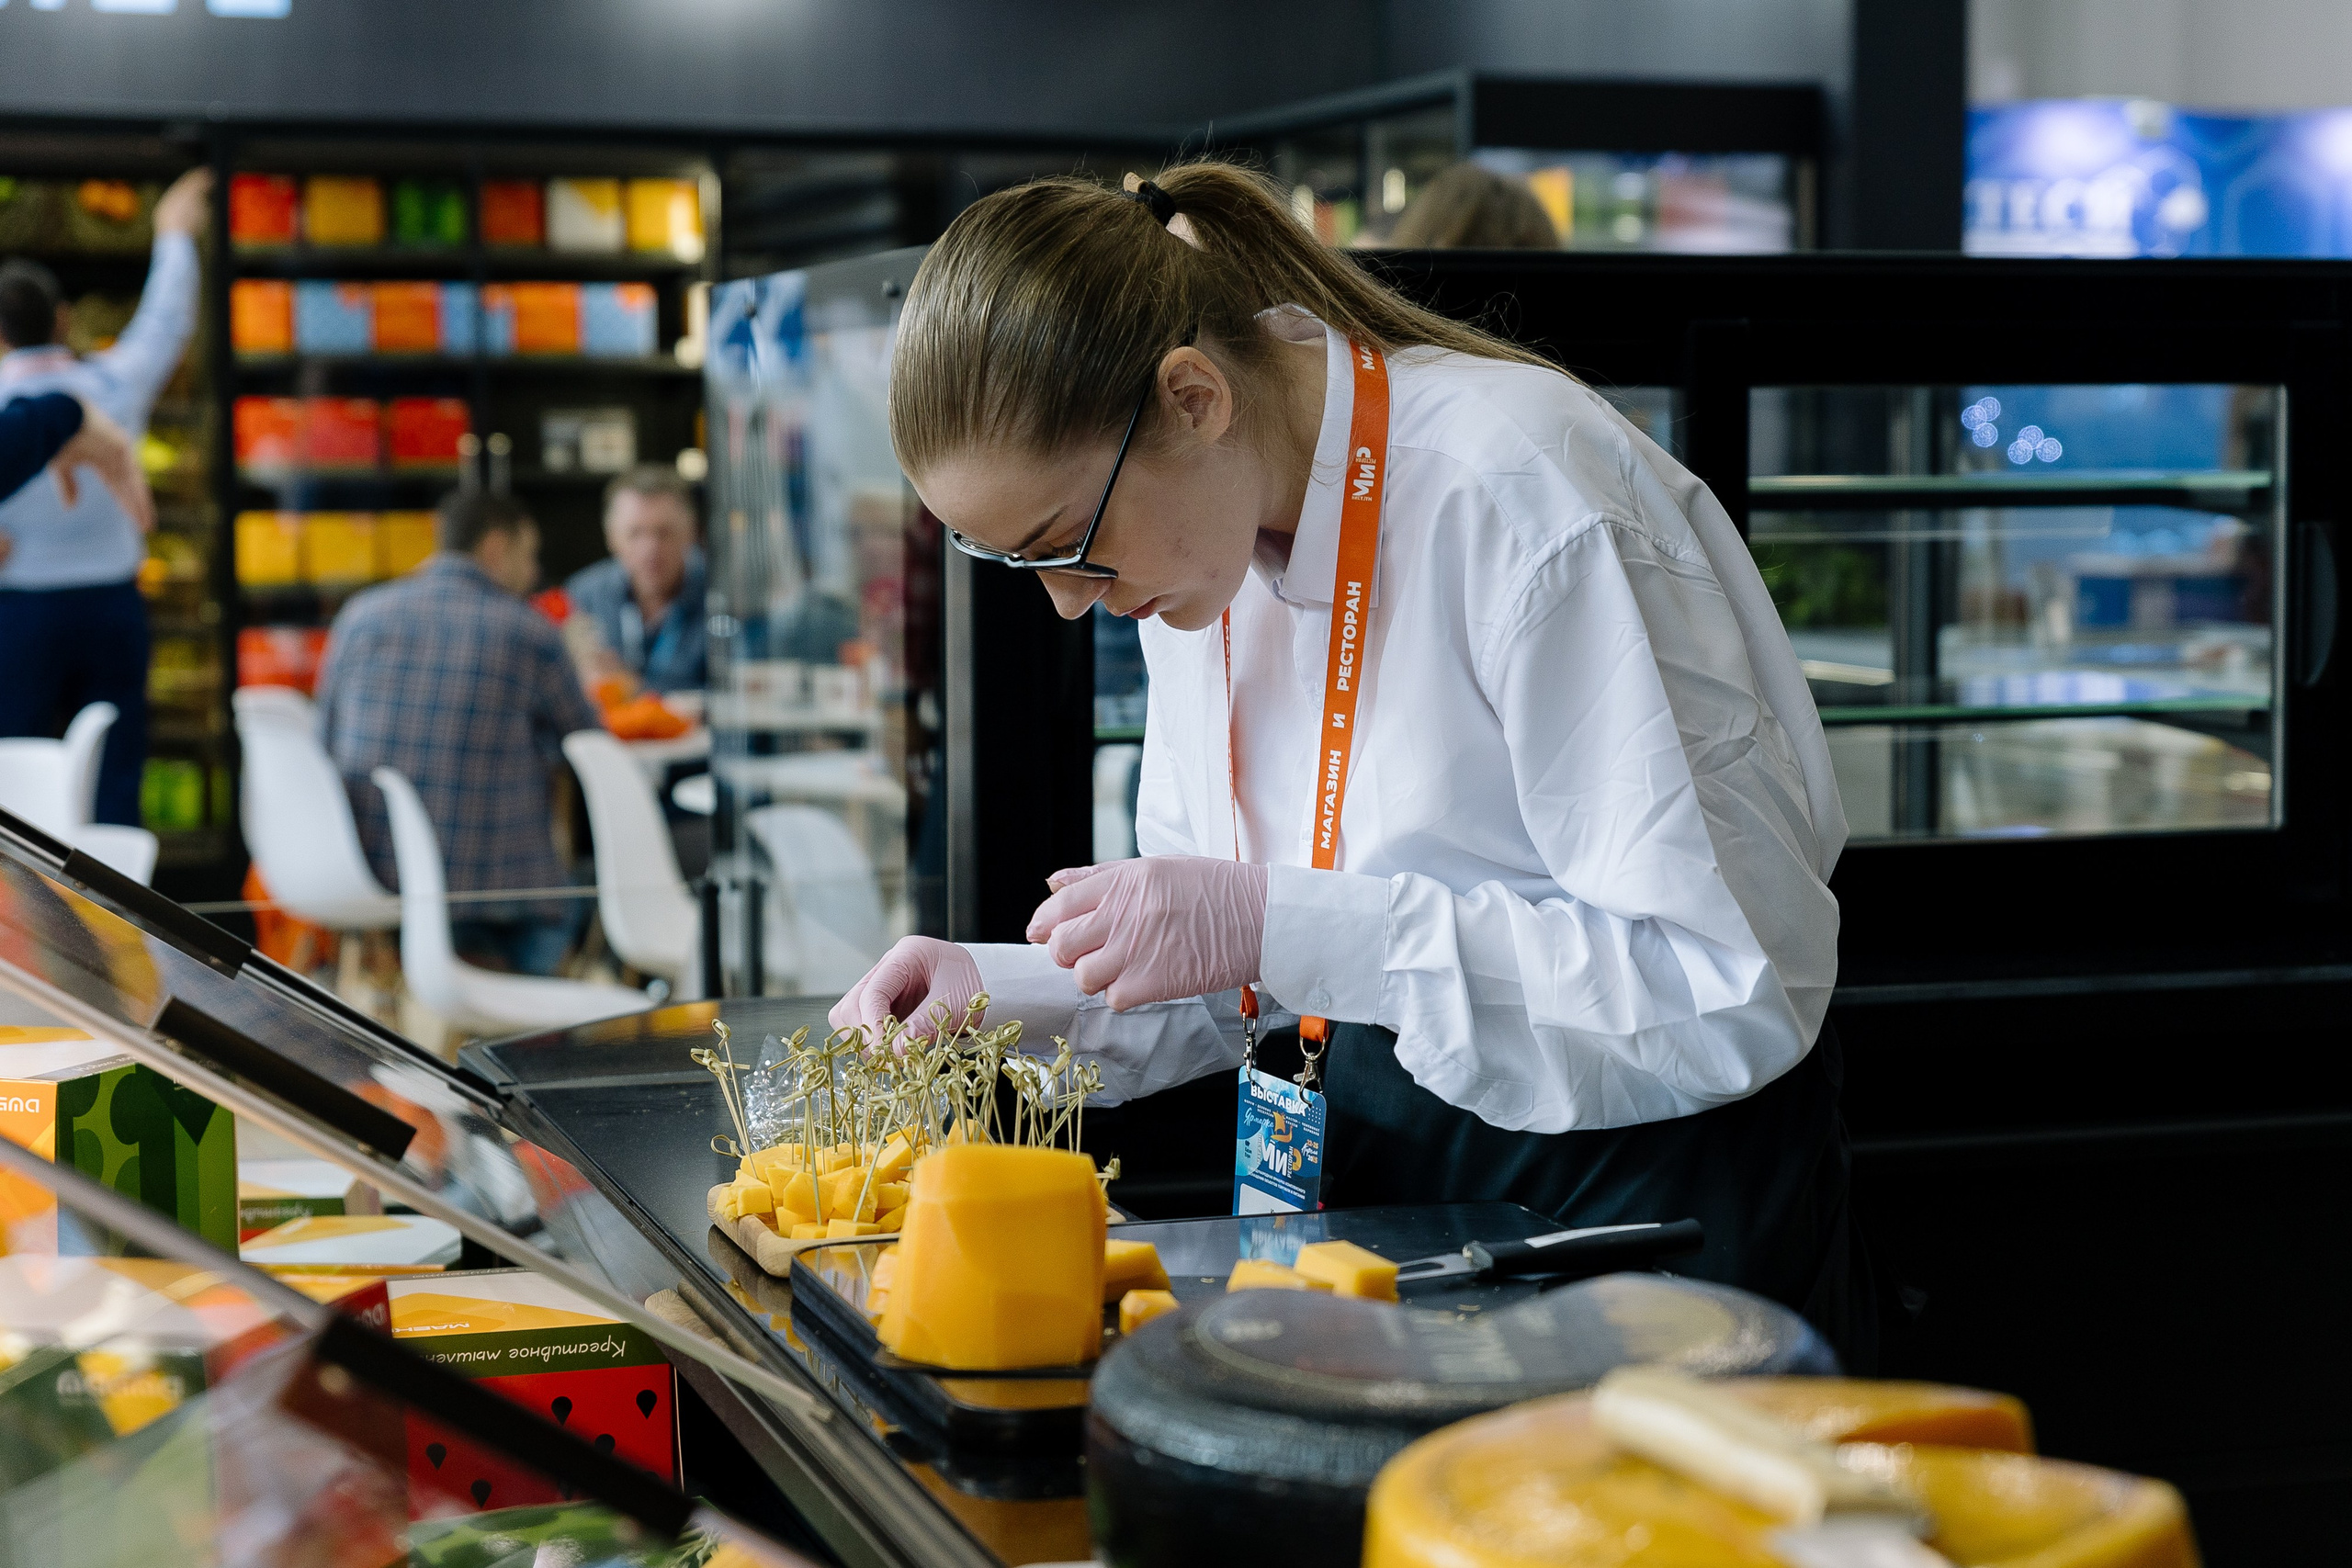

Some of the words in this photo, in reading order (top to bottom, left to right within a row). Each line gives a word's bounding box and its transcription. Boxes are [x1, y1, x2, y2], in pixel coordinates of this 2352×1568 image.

[1336, 581, 1362, 692] РЕСТОРАН
[1332, 713, 1346, 728] И
[1320, 750, 1342, 850] МАГАЗИН
[1250, 1085, 1306, 1117] ВЫСТАВКА
[419, 1348, 502, 1364] мышлен
[508, 1334, 627, 1363] Креативное
